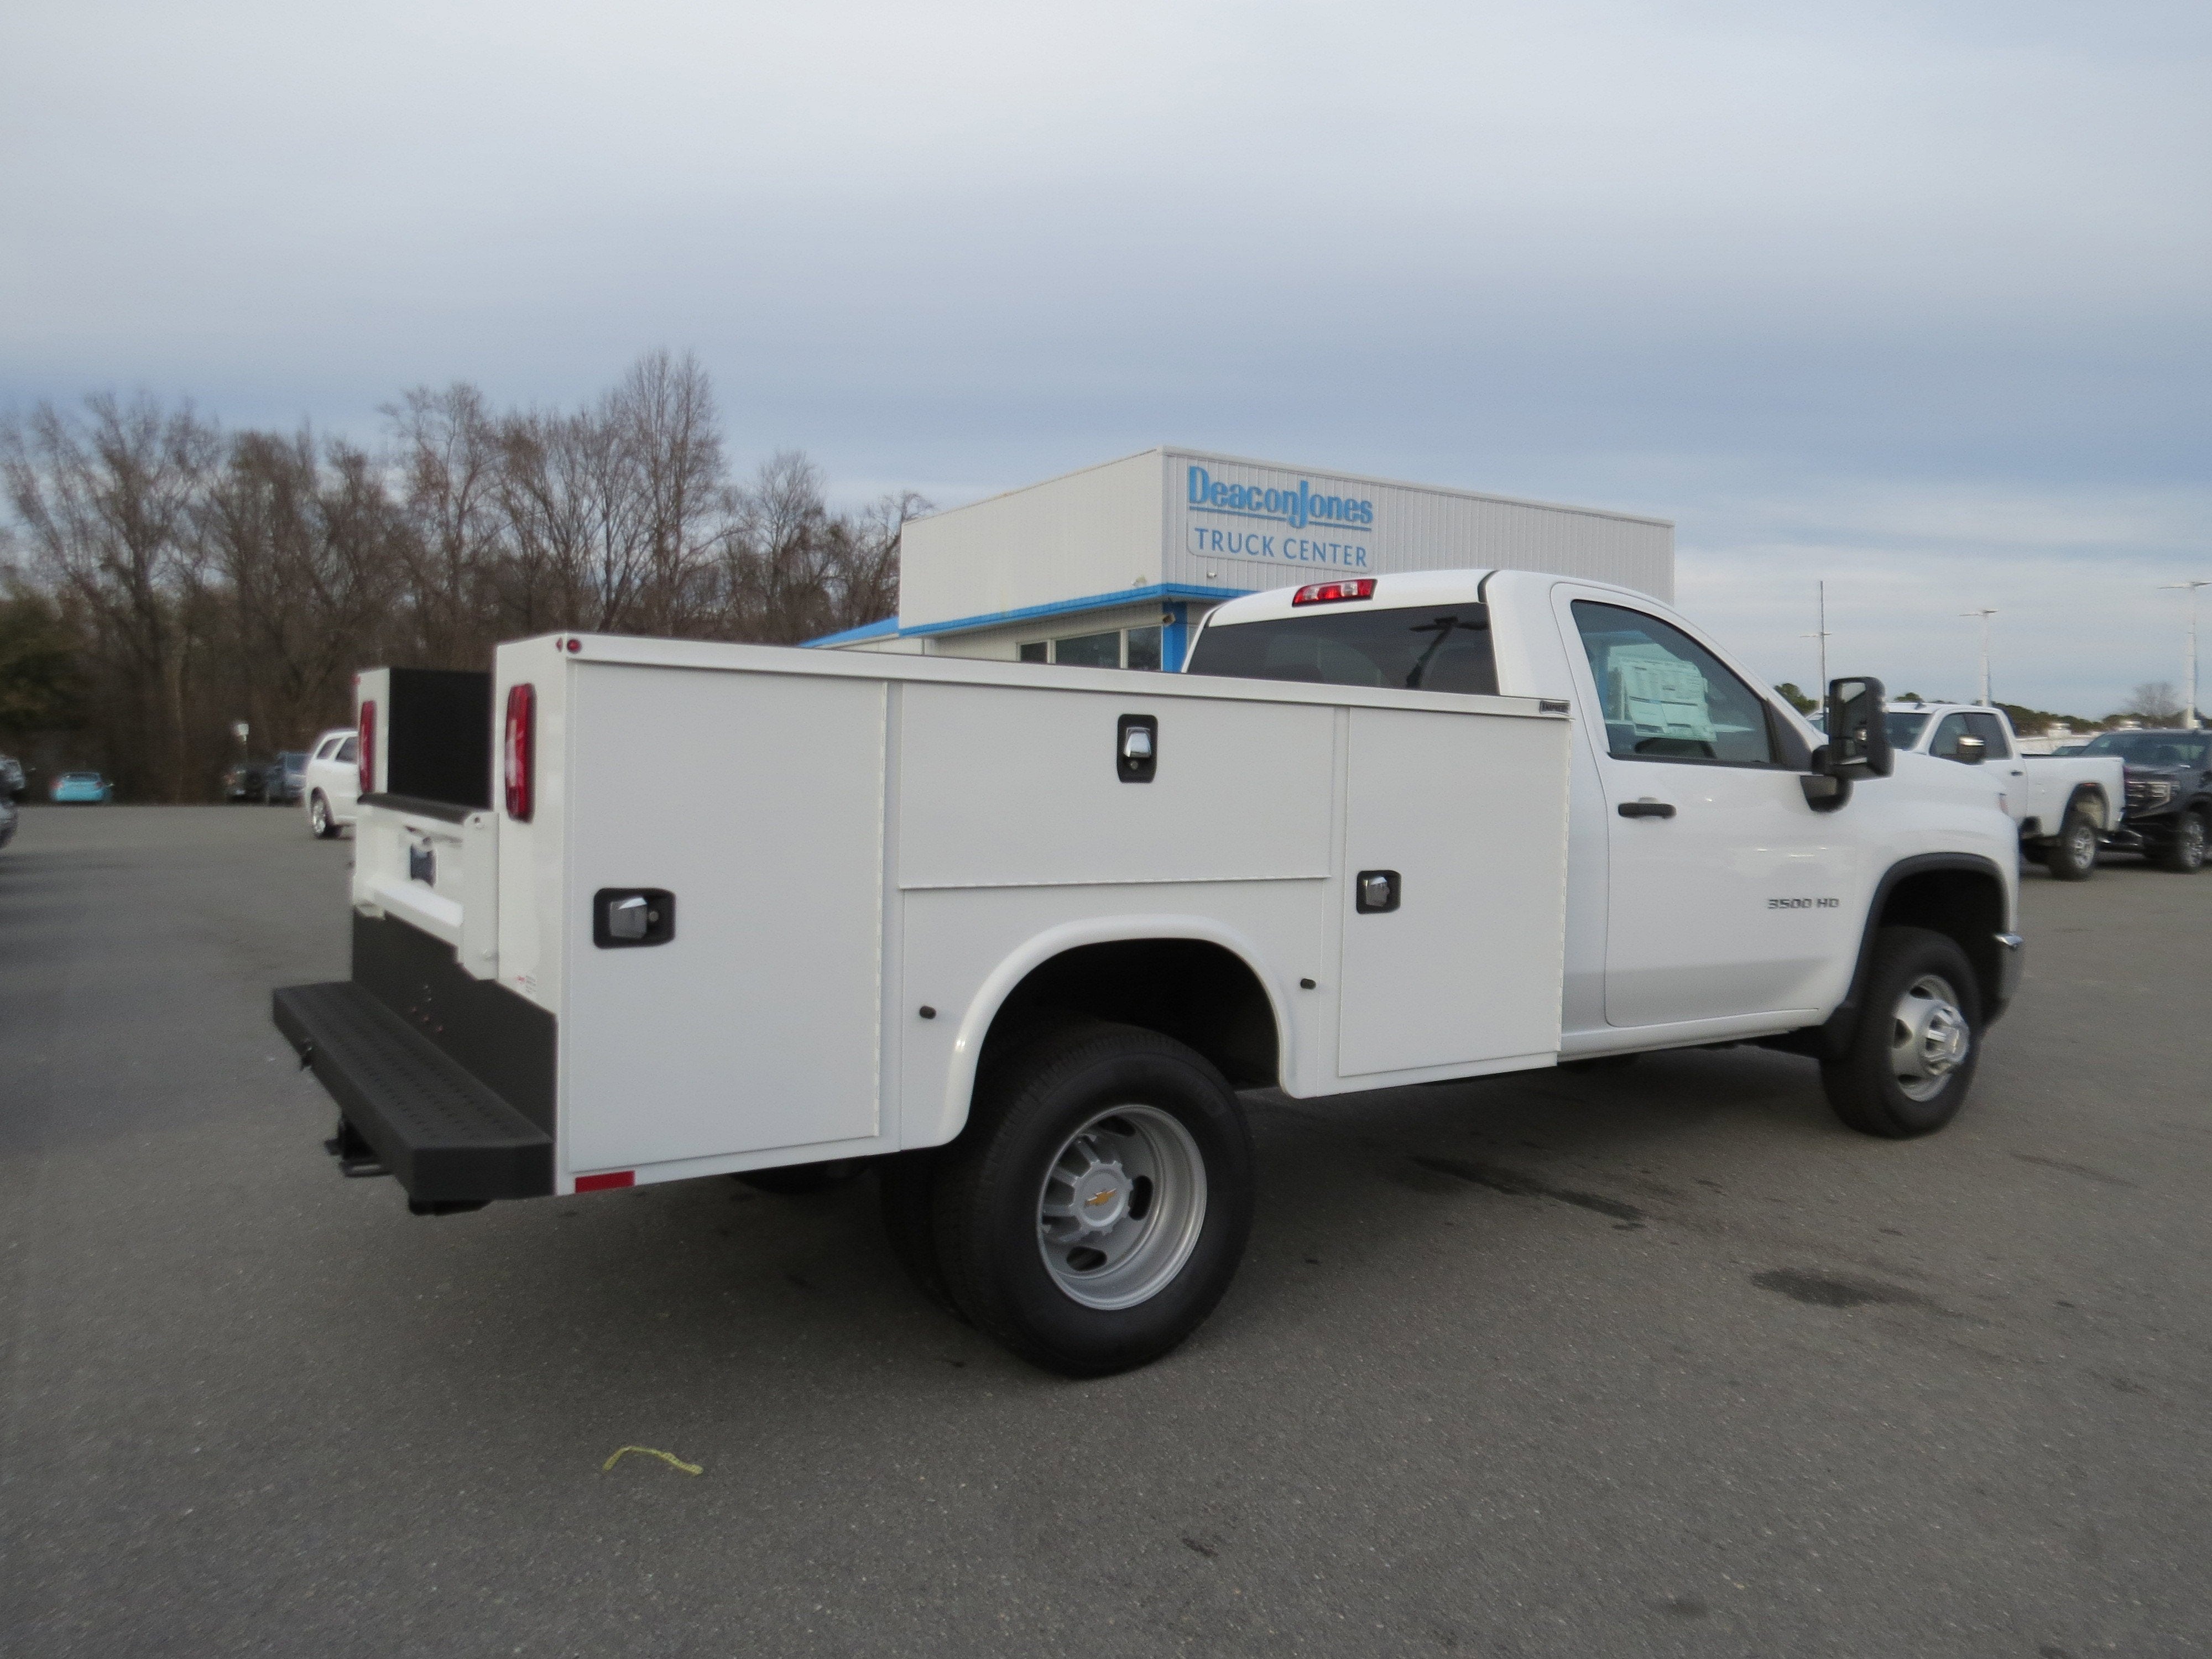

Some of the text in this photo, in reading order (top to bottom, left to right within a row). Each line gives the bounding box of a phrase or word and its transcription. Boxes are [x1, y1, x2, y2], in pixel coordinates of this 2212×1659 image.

[1194, 528, 1367, 567] TRUCK CENTER
[1768, 898, 1839, 909] 3500 HD
